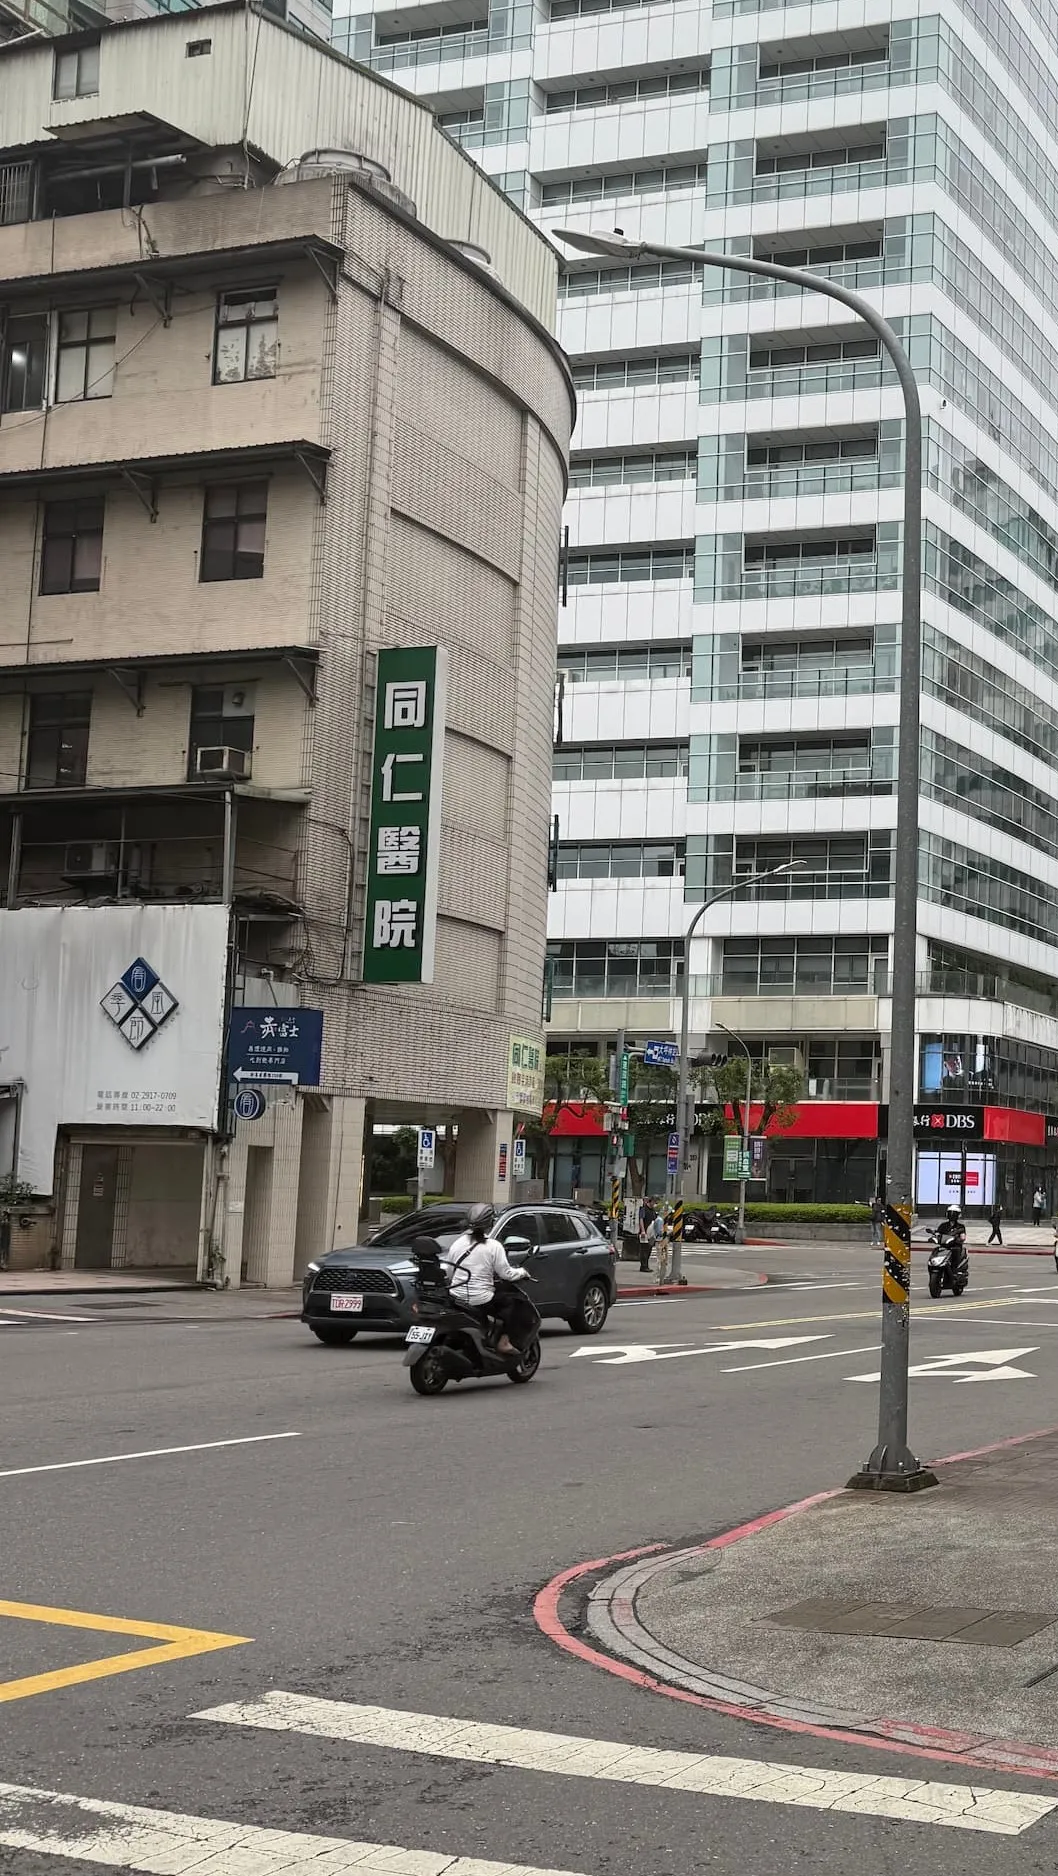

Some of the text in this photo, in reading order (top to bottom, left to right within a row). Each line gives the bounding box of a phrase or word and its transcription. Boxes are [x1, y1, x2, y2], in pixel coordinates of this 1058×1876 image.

[372, 680, 428, 948] 同仁醫院
[946, 1114, 976, 1129] DBS
